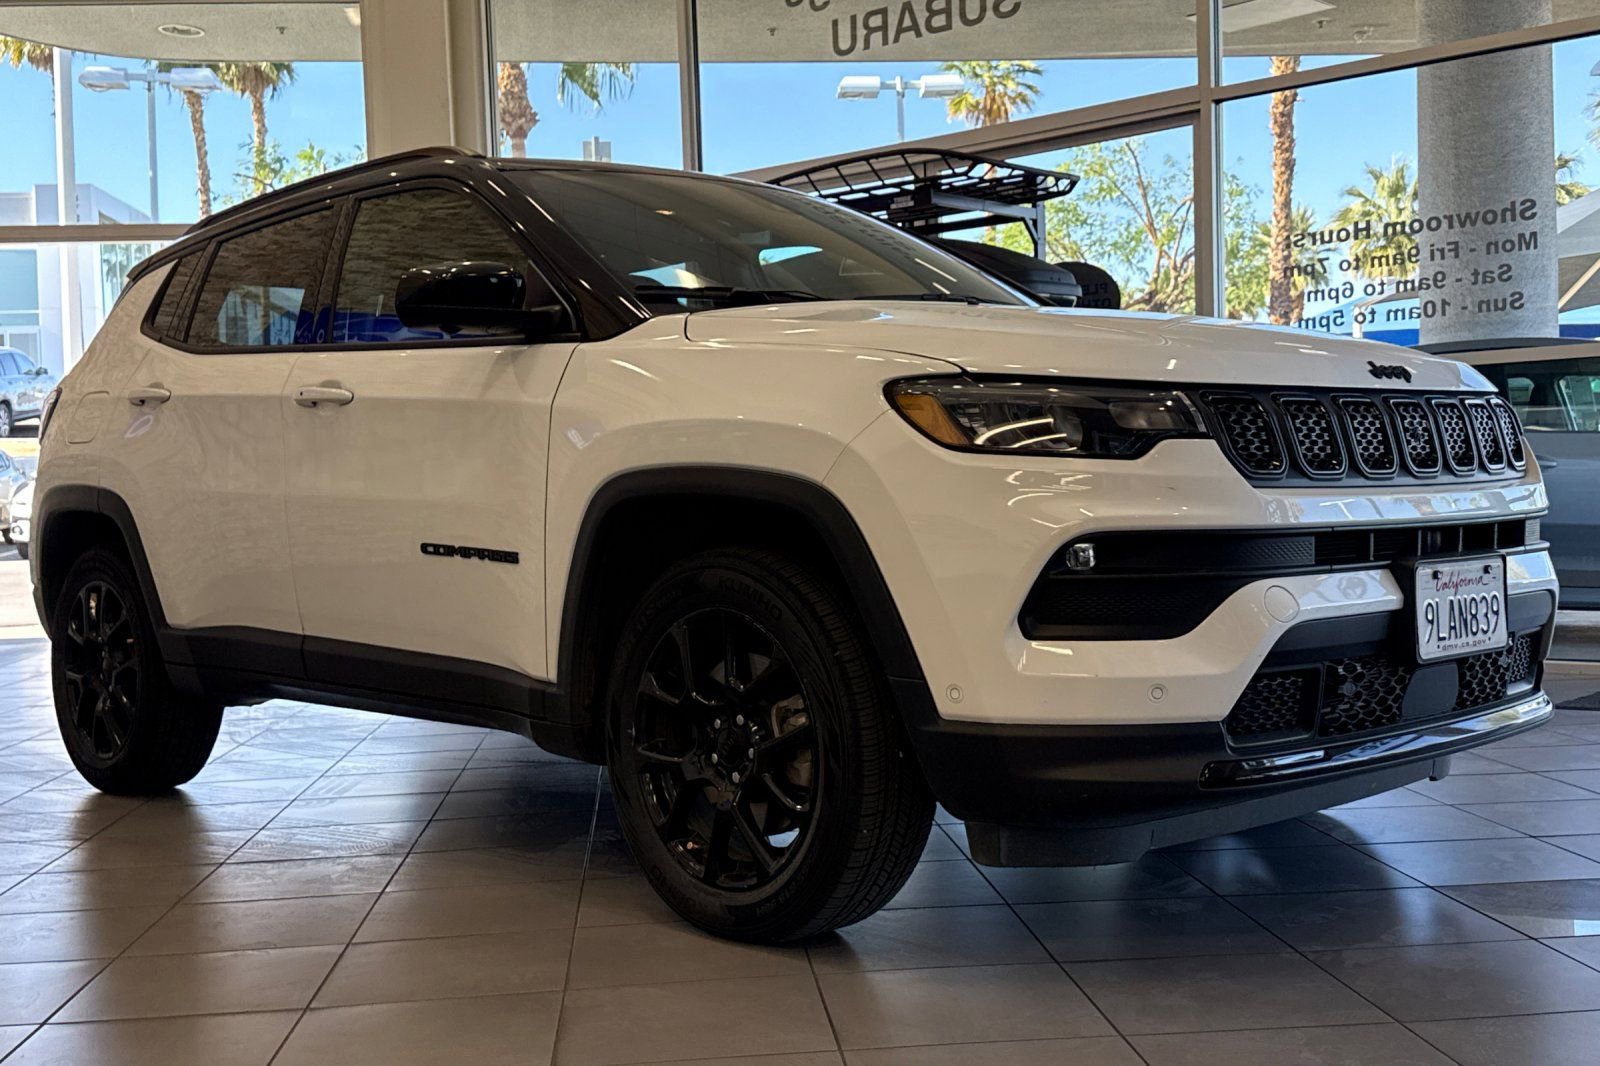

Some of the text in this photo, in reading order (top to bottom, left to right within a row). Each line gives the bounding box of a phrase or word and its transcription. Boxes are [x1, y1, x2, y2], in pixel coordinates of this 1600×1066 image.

[420, 542, 519, 565] COMPASS
[1433, 570, 1490, 596] California
[1424, 592, 1500, 644] 9LAN839
[1442, 638, 1487, 651] dmv.ca.gov
